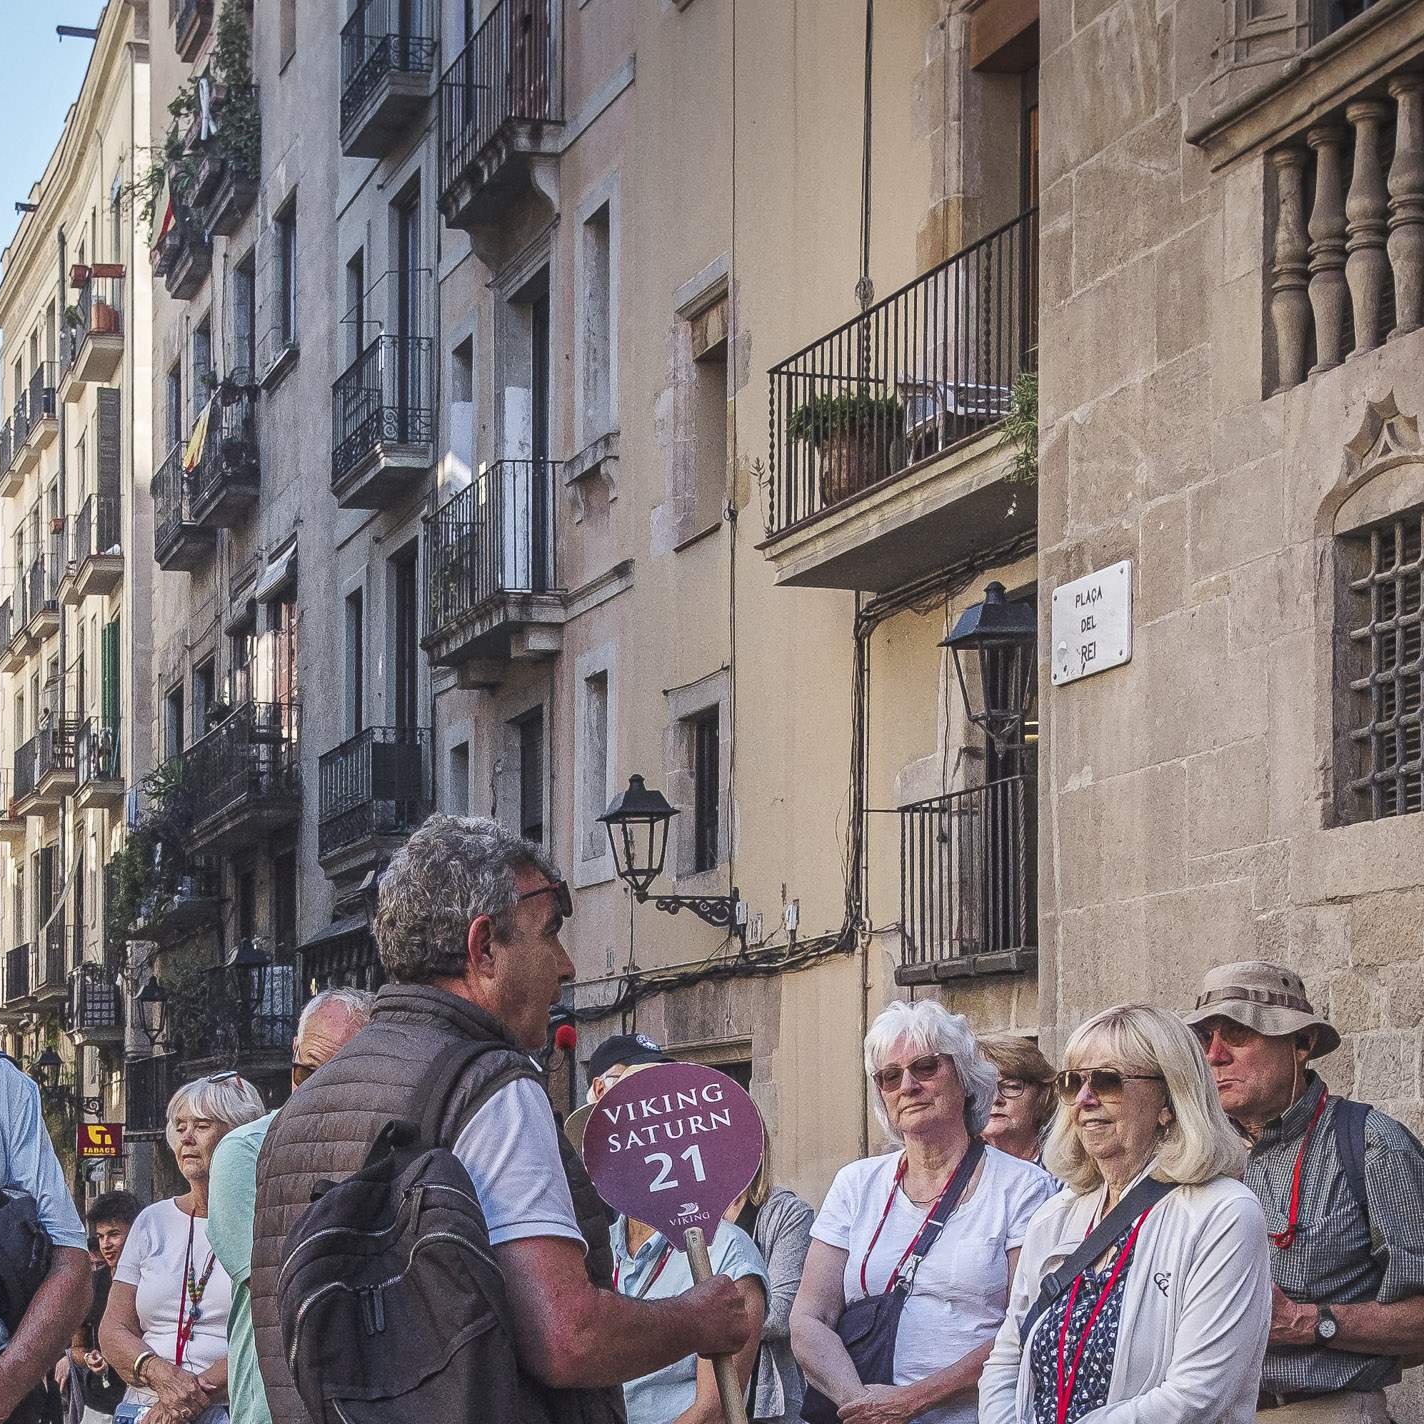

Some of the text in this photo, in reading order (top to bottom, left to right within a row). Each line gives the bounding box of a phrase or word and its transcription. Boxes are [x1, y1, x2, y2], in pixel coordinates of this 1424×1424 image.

[1075, 585, 1103, 609] PLAÇA
[1080, 615, 1097, 634] DEL
[1080, 641, 1097, 664] REI
[602, 1083, 725, 1125] VIKING
[608, 1108, 732, 1153] SATURN
[644, 1144, 706, 1193] 21
[669, 1211, 710, 1226] VIKING
